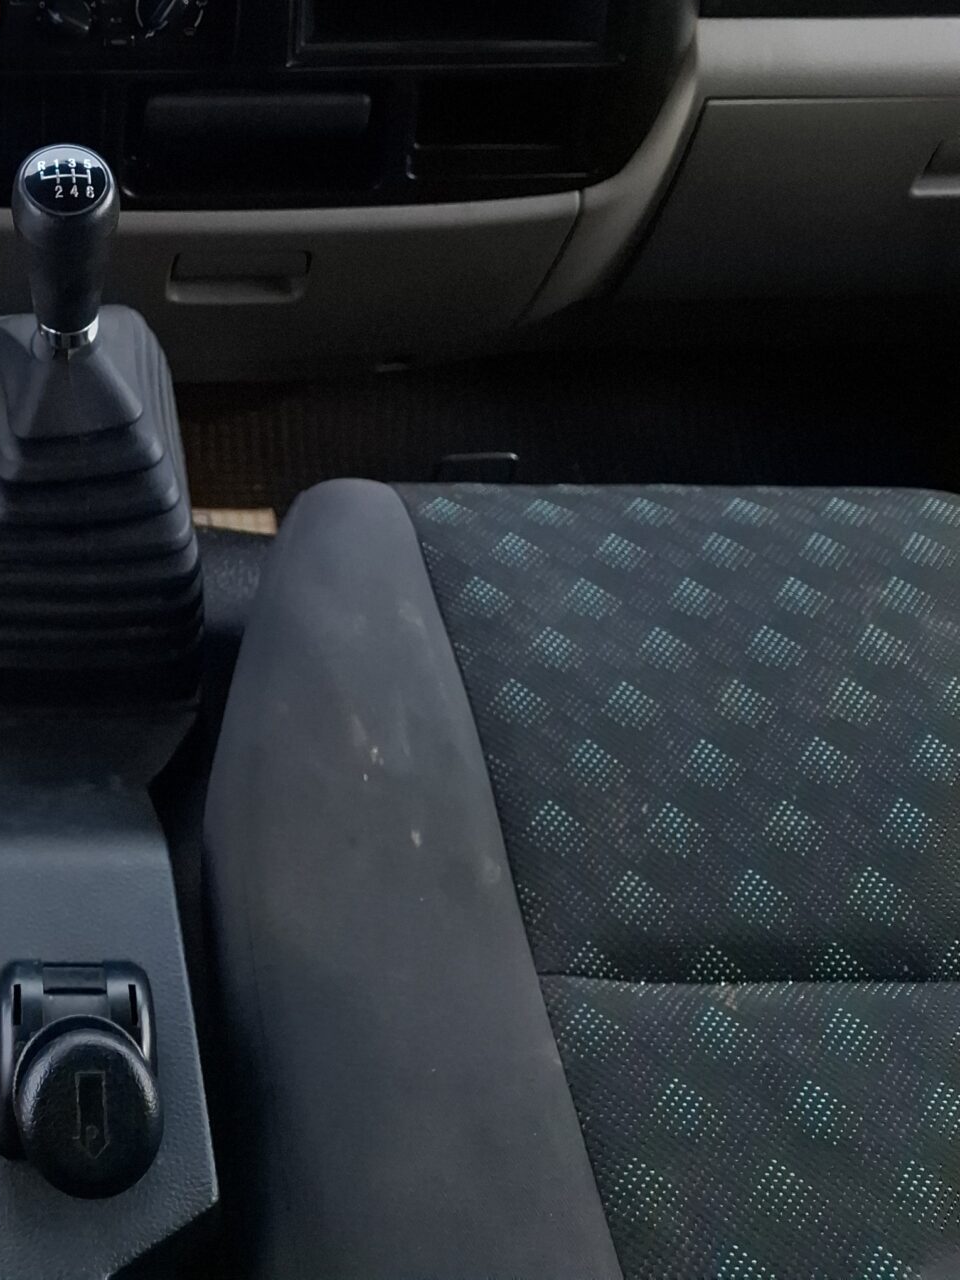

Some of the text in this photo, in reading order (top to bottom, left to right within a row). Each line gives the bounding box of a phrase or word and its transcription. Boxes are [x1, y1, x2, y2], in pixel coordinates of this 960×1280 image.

[37, 158, 92, 171] R 1 3 5
[54, 184, 95, 199] 2 4 6
